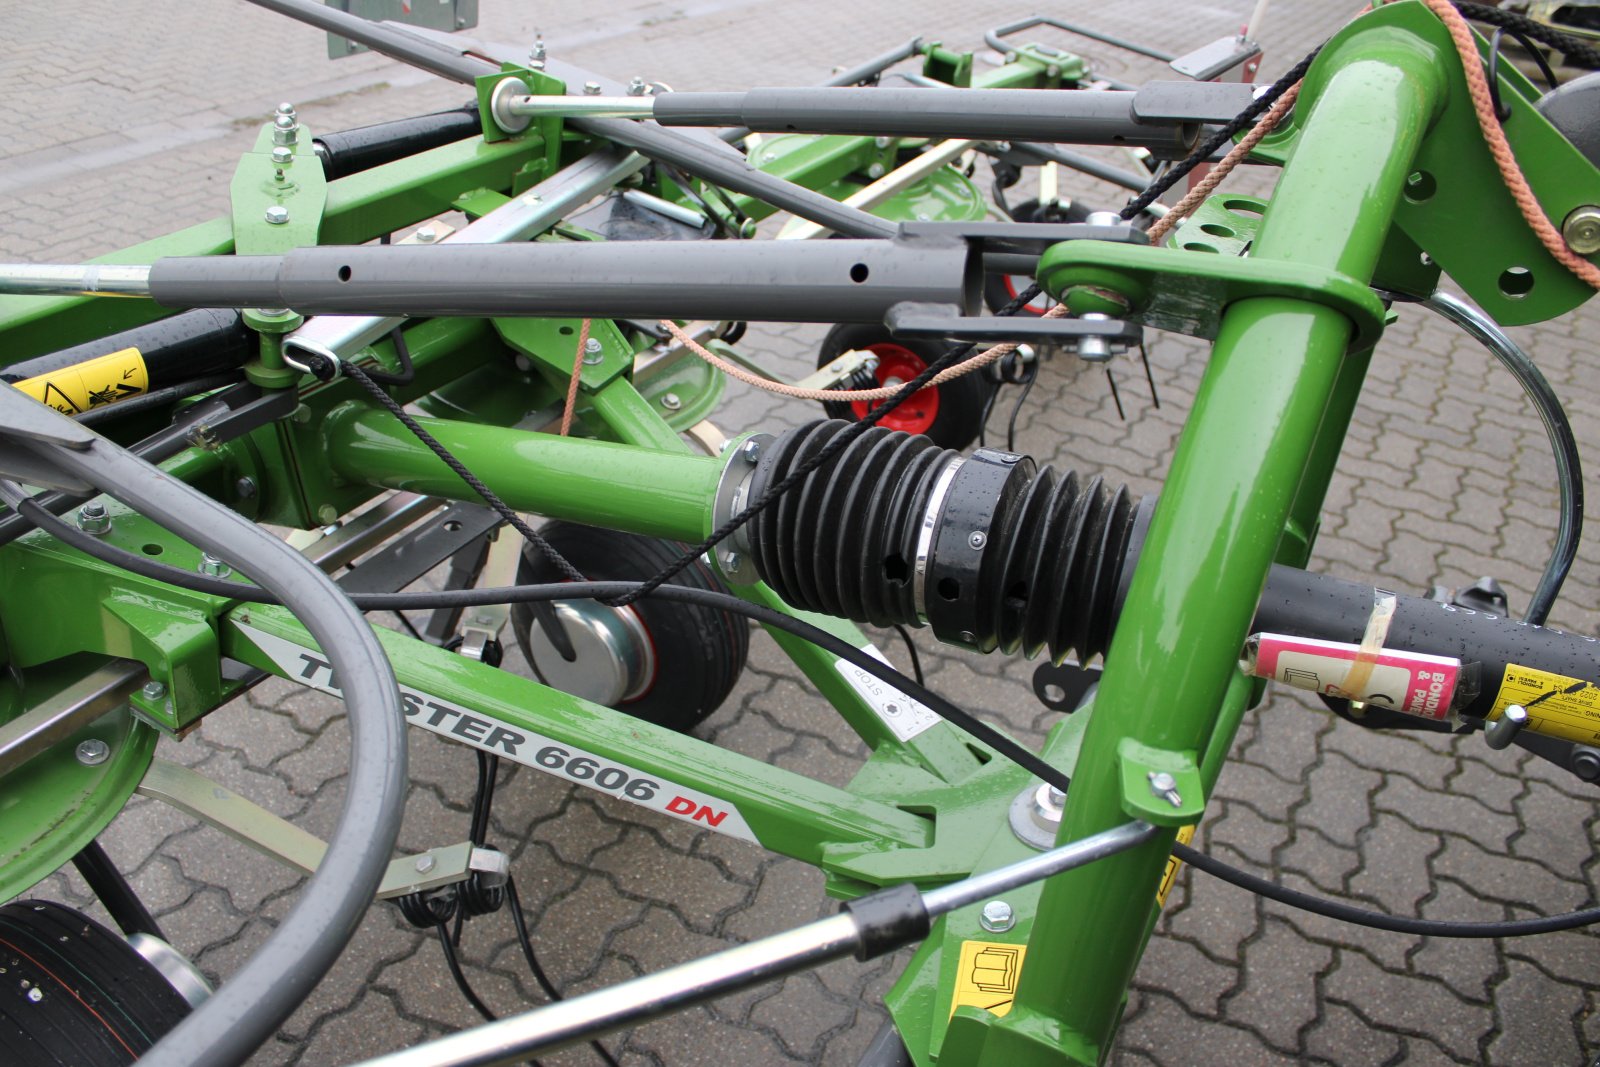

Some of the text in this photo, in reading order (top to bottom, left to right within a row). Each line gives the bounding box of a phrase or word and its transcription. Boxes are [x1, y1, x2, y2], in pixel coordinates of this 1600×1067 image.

[854, 669, 883, 696] STOP
[1408, 670, 1431, 716] & PAVE
[1423, 672, 1445, 719] BONDIO
[1580, 690, 1598, 701] 2022
[300, 653, 728, 827] TSTER 6606 DN
